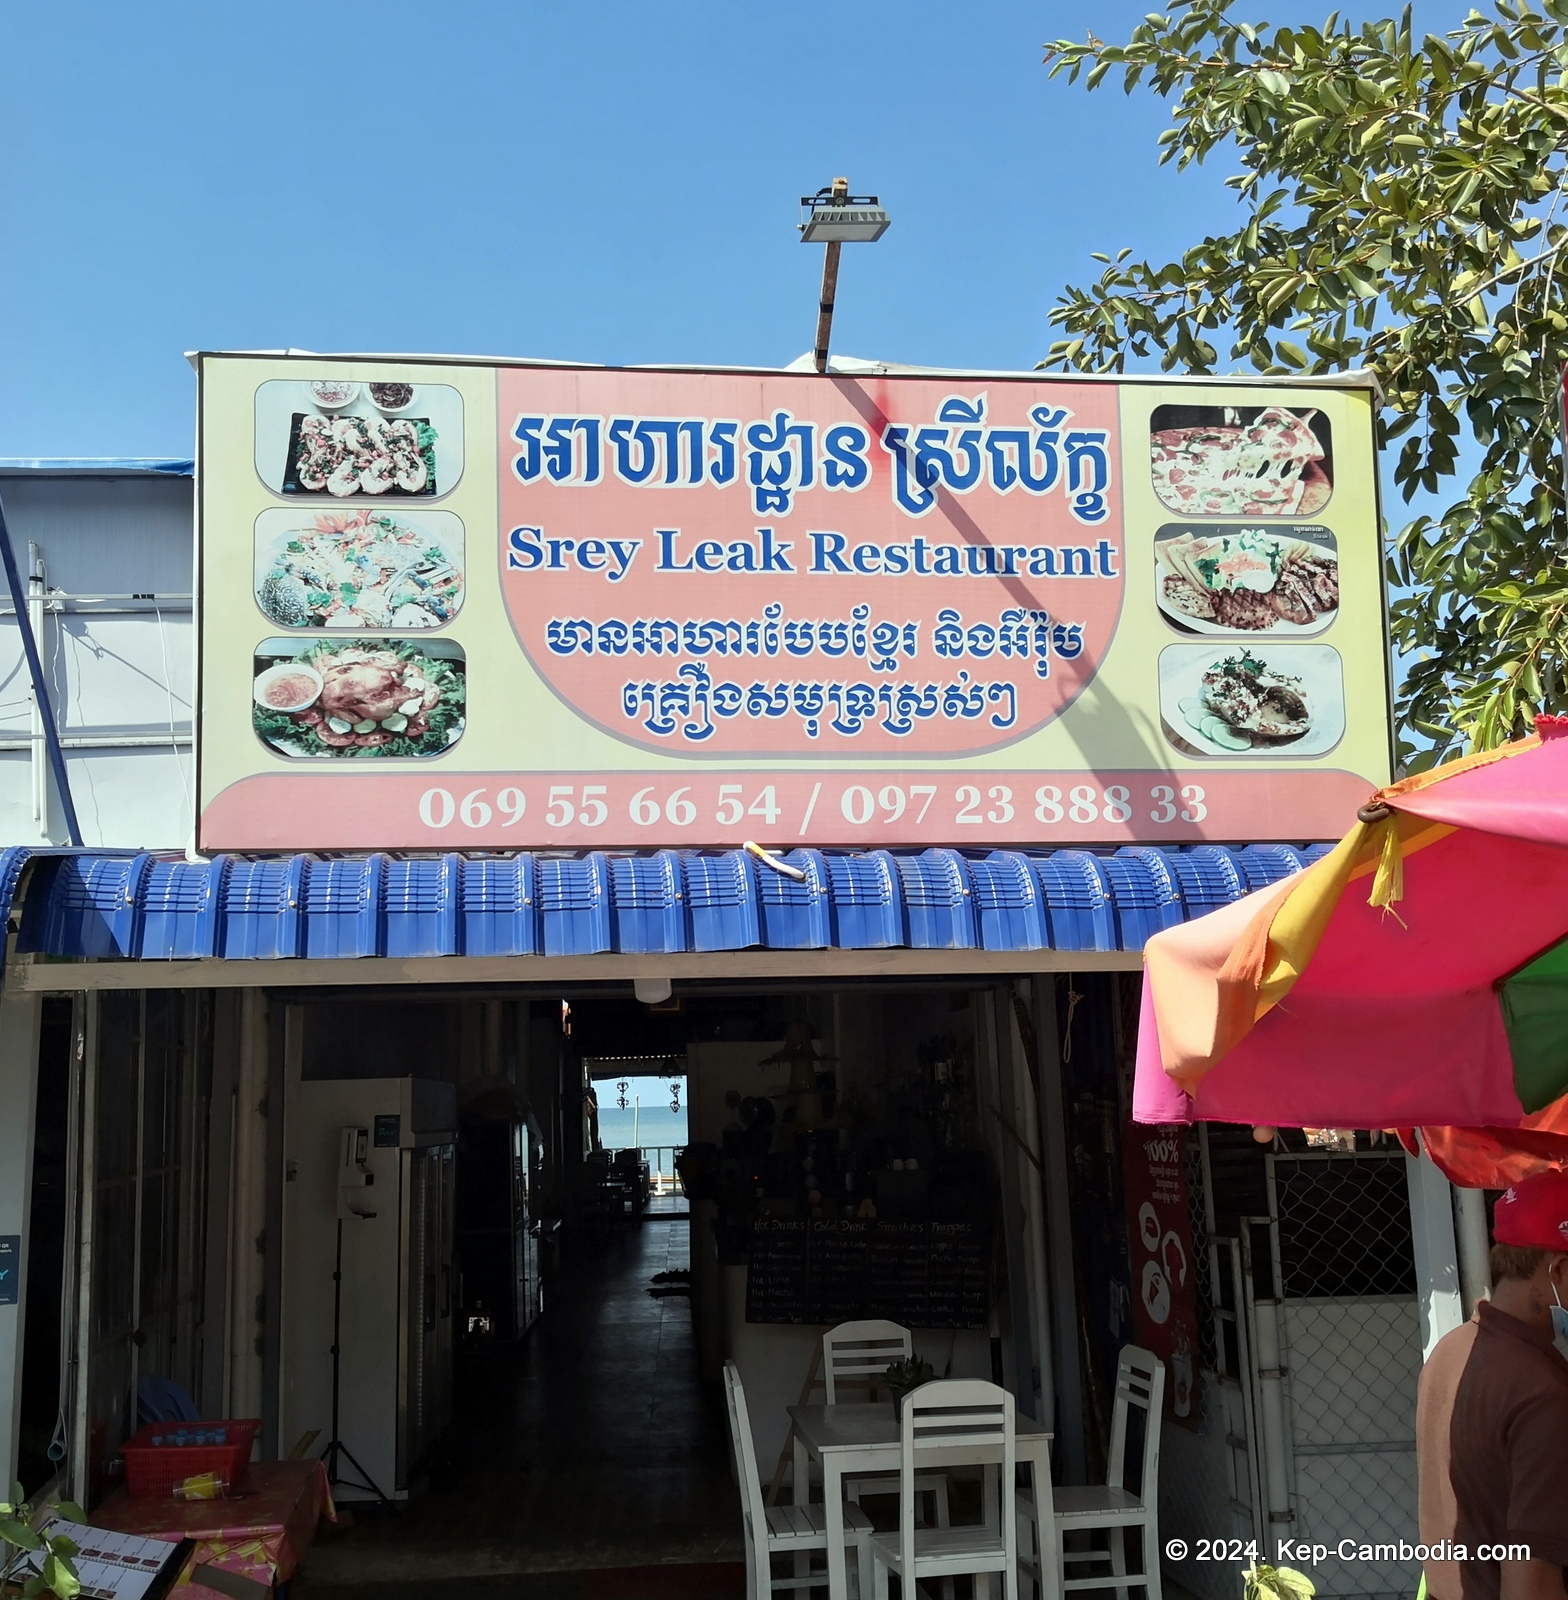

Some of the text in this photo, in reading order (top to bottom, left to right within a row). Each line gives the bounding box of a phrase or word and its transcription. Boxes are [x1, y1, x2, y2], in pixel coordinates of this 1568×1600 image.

[513, 396, 1108, 523] អាហារដ្ឋាន ស្រីល័ក្ខ
[508, 526, 1118, 581] Srey Leak Restaurant
[418, 782, 1208, 836] 069 55 66 54 / 097 23 888 33
